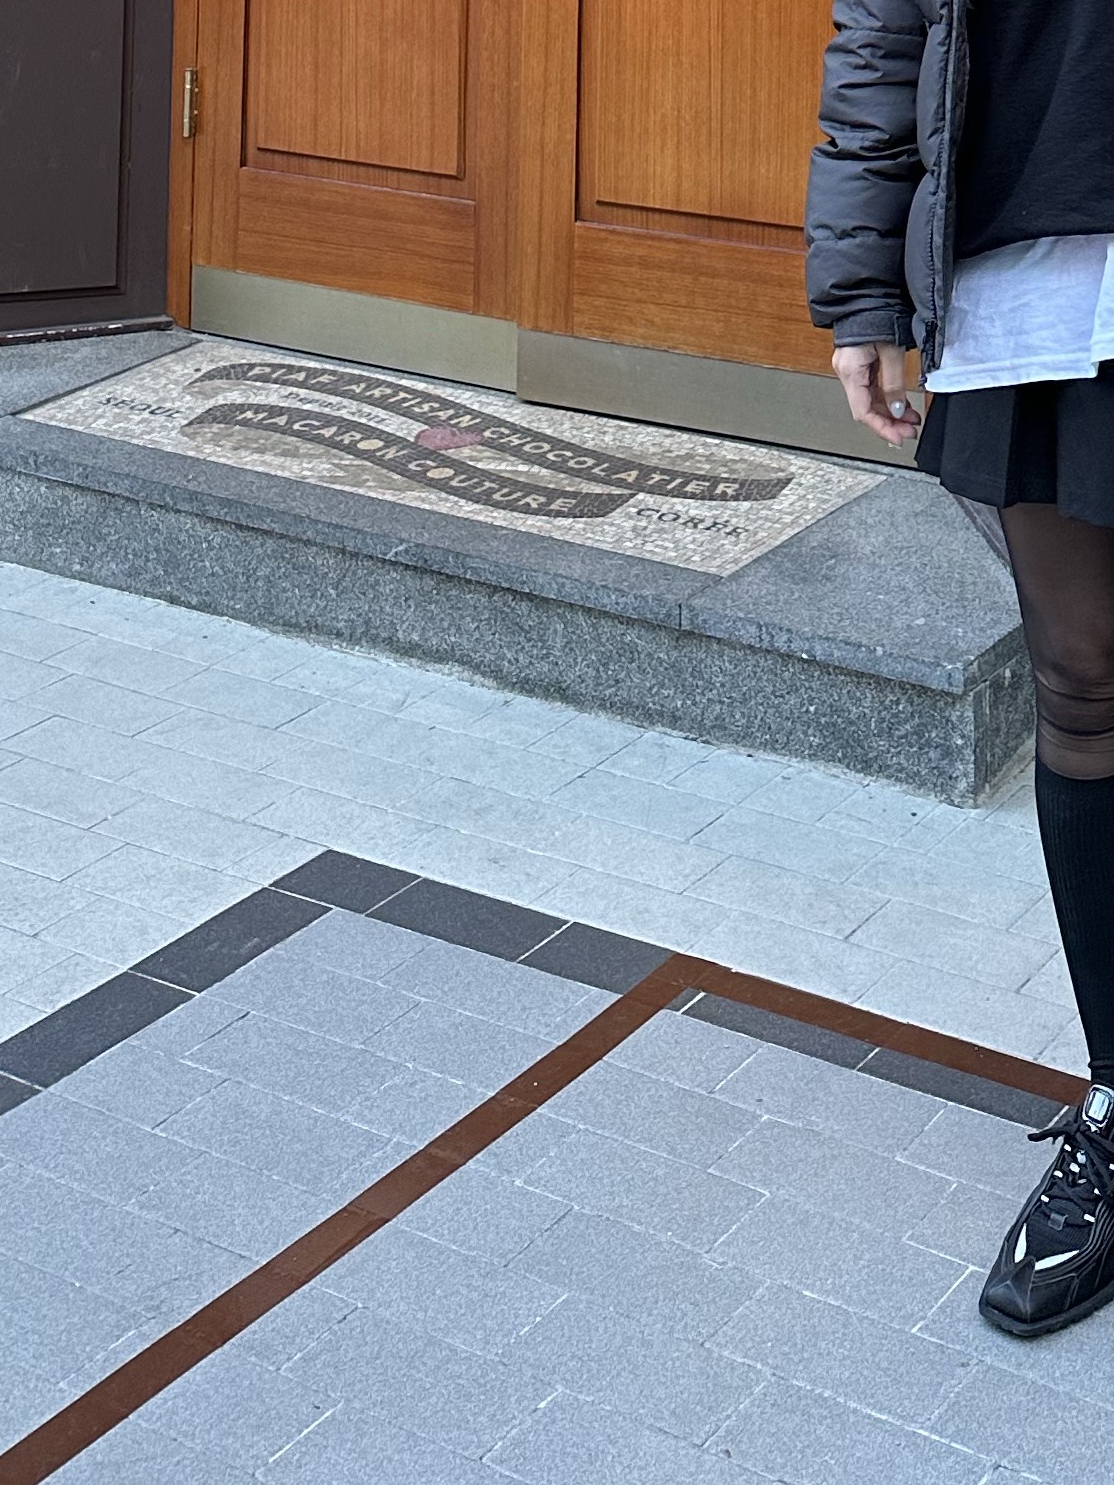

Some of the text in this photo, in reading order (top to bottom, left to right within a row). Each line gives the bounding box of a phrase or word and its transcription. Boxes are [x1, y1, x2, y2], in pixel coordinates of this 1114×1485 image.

[236, 410, 578, 513] MACARON COUTURE
[247, 365, 741, 496] PIAF ARTISAN CHOCOLATIER
